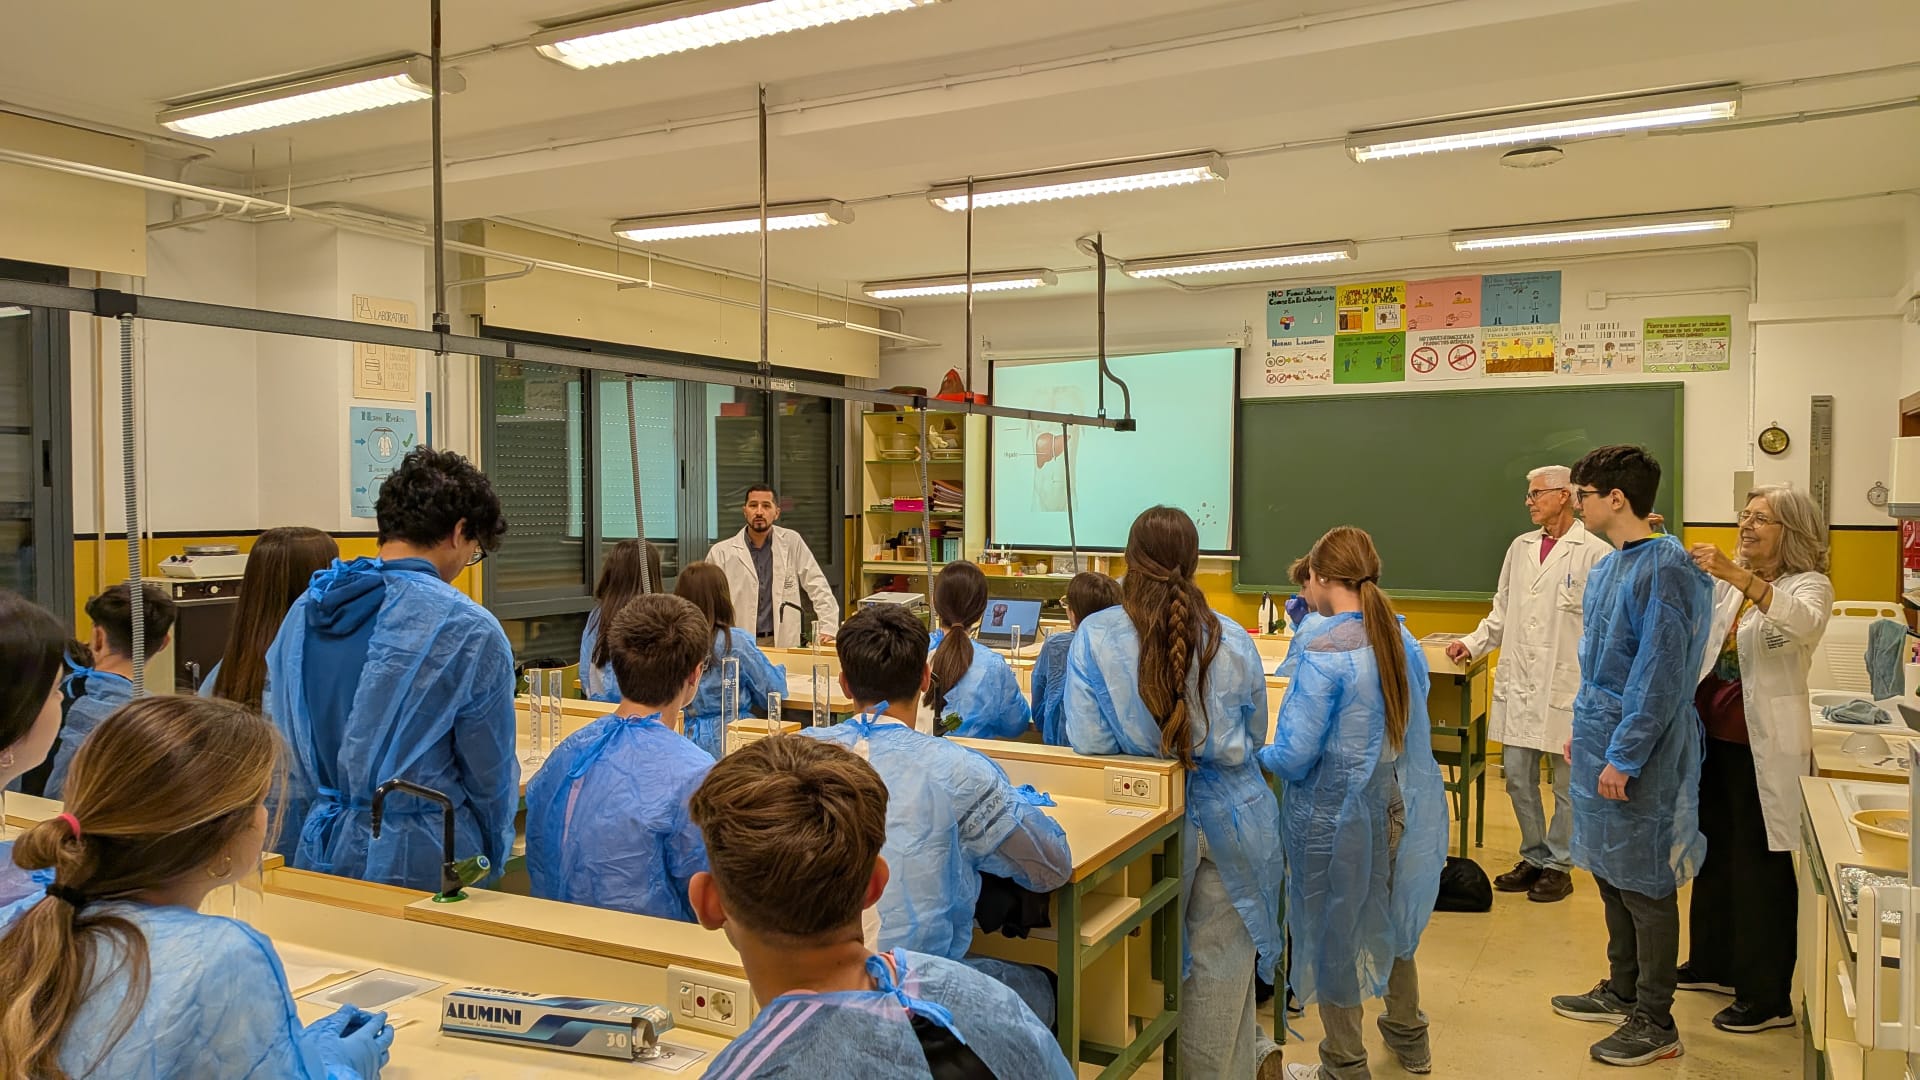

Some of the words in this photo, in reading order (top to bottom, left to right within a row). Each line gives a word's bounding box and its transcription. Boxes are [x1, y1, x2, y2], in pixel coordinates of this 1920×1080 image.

[374, 309, 409, 324] LABORATORIO
[446, 1002, 522, 1026] ALUMINI
[606, 1032, 627, 1049] 30
